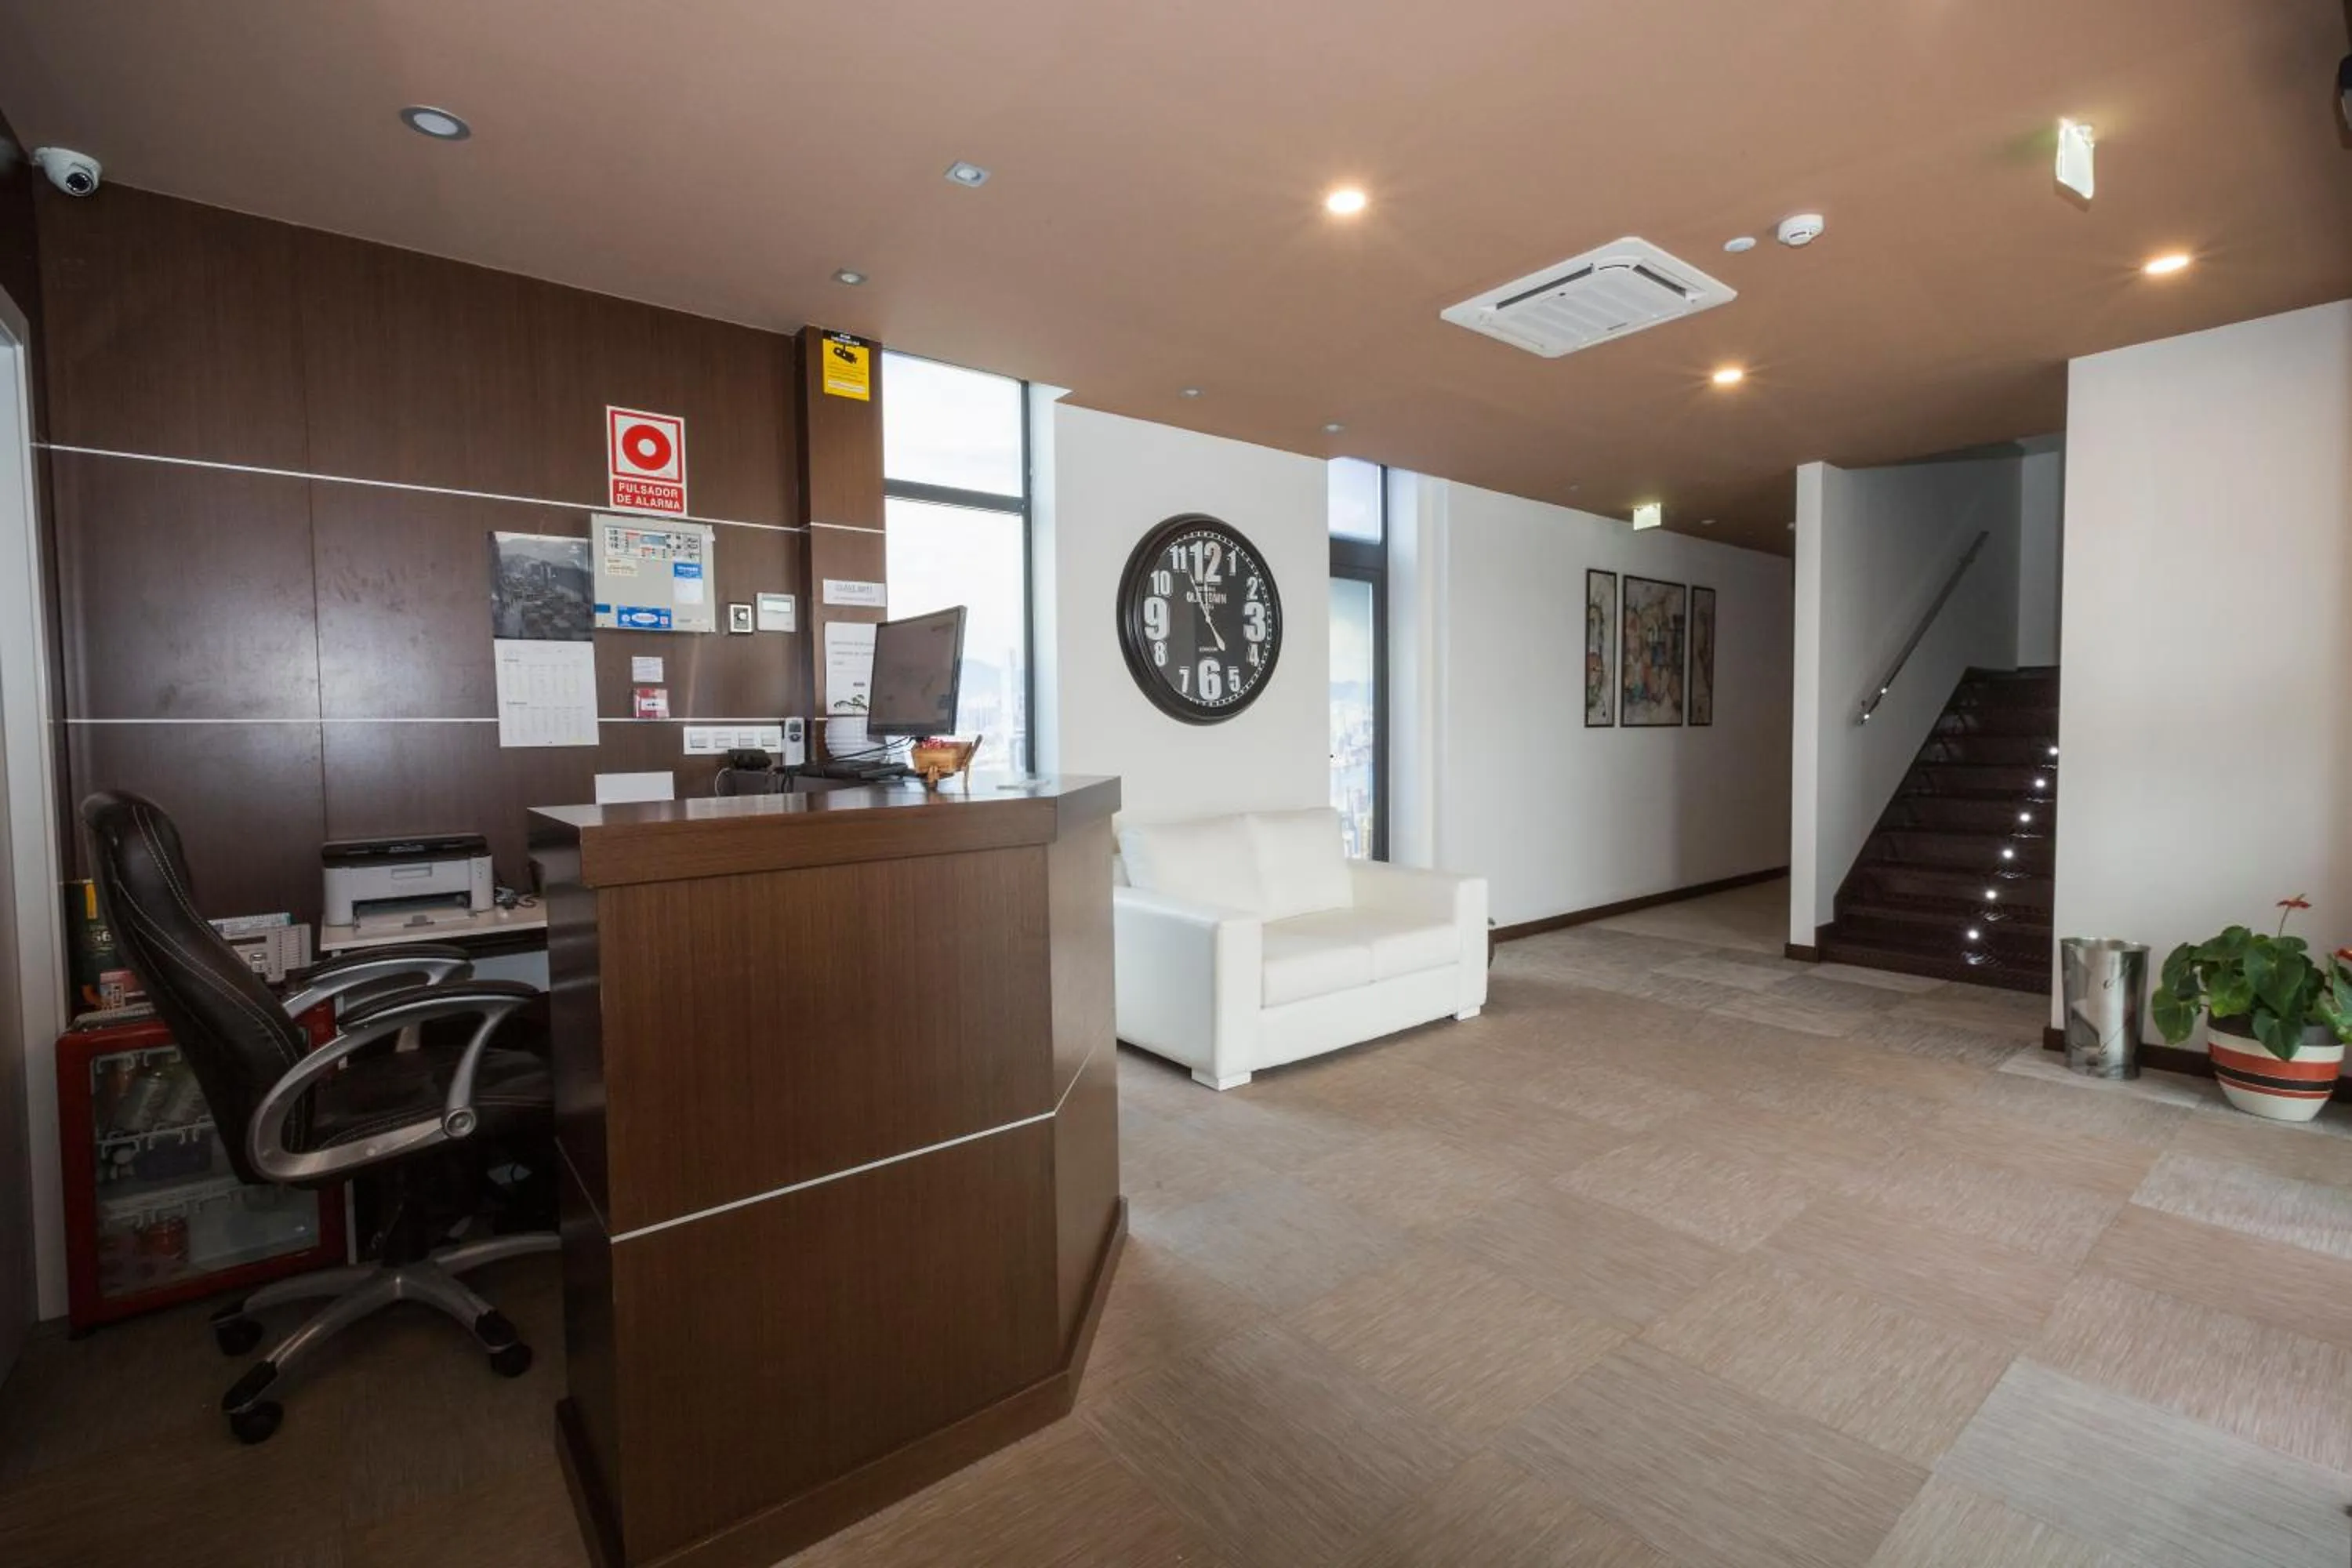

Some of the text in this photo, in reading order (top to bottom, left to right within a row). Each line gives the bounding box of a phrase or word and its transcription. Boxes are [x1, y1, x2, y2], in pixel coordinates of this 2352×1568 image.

[616, 493, 681, 509] DE ALARMA
[619, 482, 678, 498] PULSADOR
[1169, 546, 1187, 570] 11
[1189, 540, 1222, 584] 12
[1226, 550, 1237, 574] 1
[1150, 570, 1171, 597] 10
[1246, 576, 1258, 601] 2
[1144, 596, 1169, 641] 9
[1243, 601, 1266, 642] 3
[1153, 641, 1167, 666] 8
[1247, 643, 1260, 666] 4
[1178, 668, 1190, 694] 7
[1198, 659, 1222, 701] 6
[1228, 668, 1241, 692] 5
